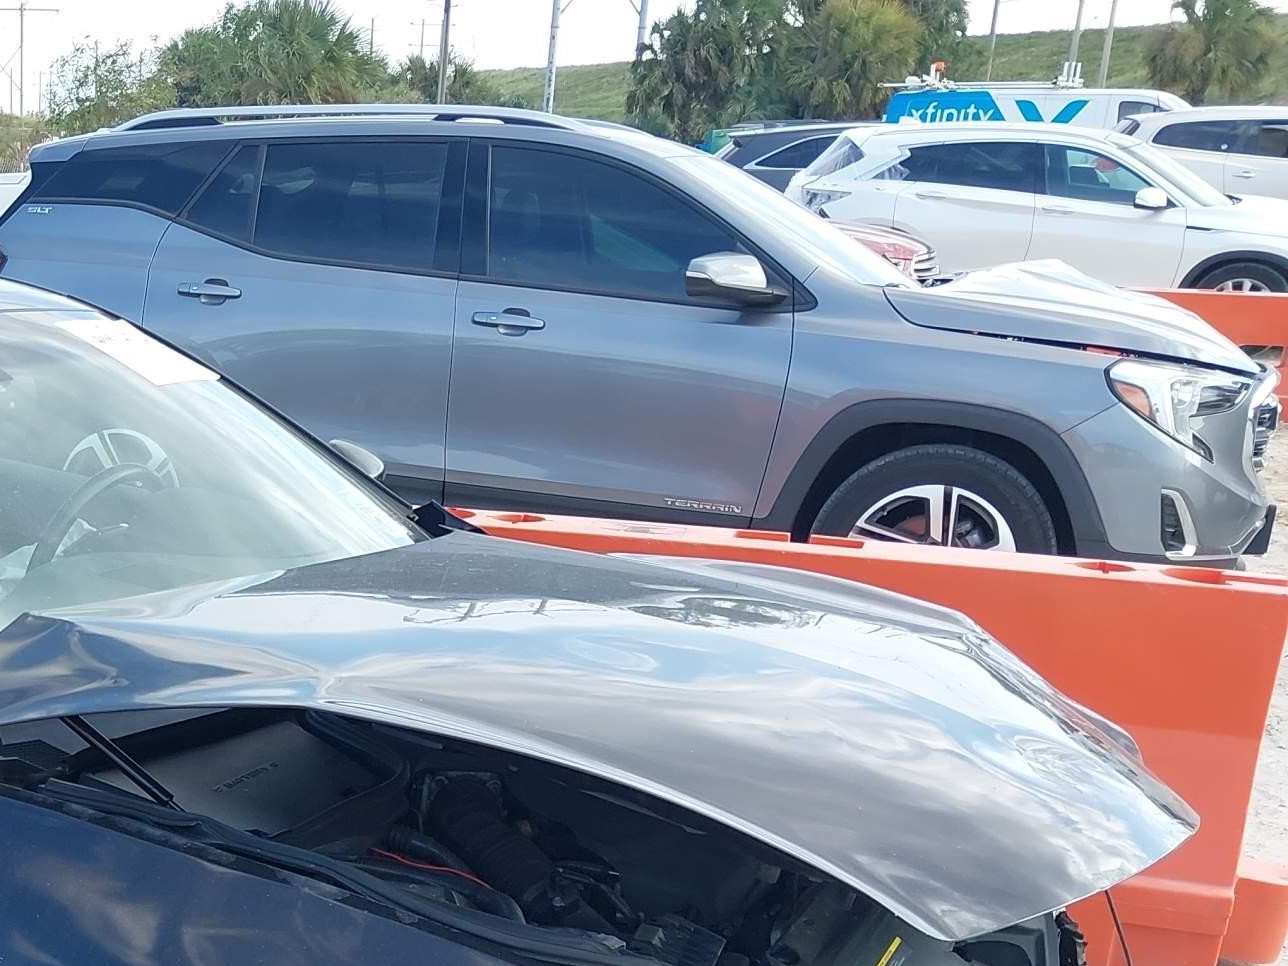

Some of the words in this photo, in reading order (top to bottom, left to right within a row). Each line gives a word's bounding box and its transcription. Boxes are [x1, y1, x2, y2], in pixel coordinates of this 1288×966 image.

[911, 102, 994, 122] xfinity
[27, 206, 53, 214] SLT
[664, 498, 742, 513] TERRAIN
